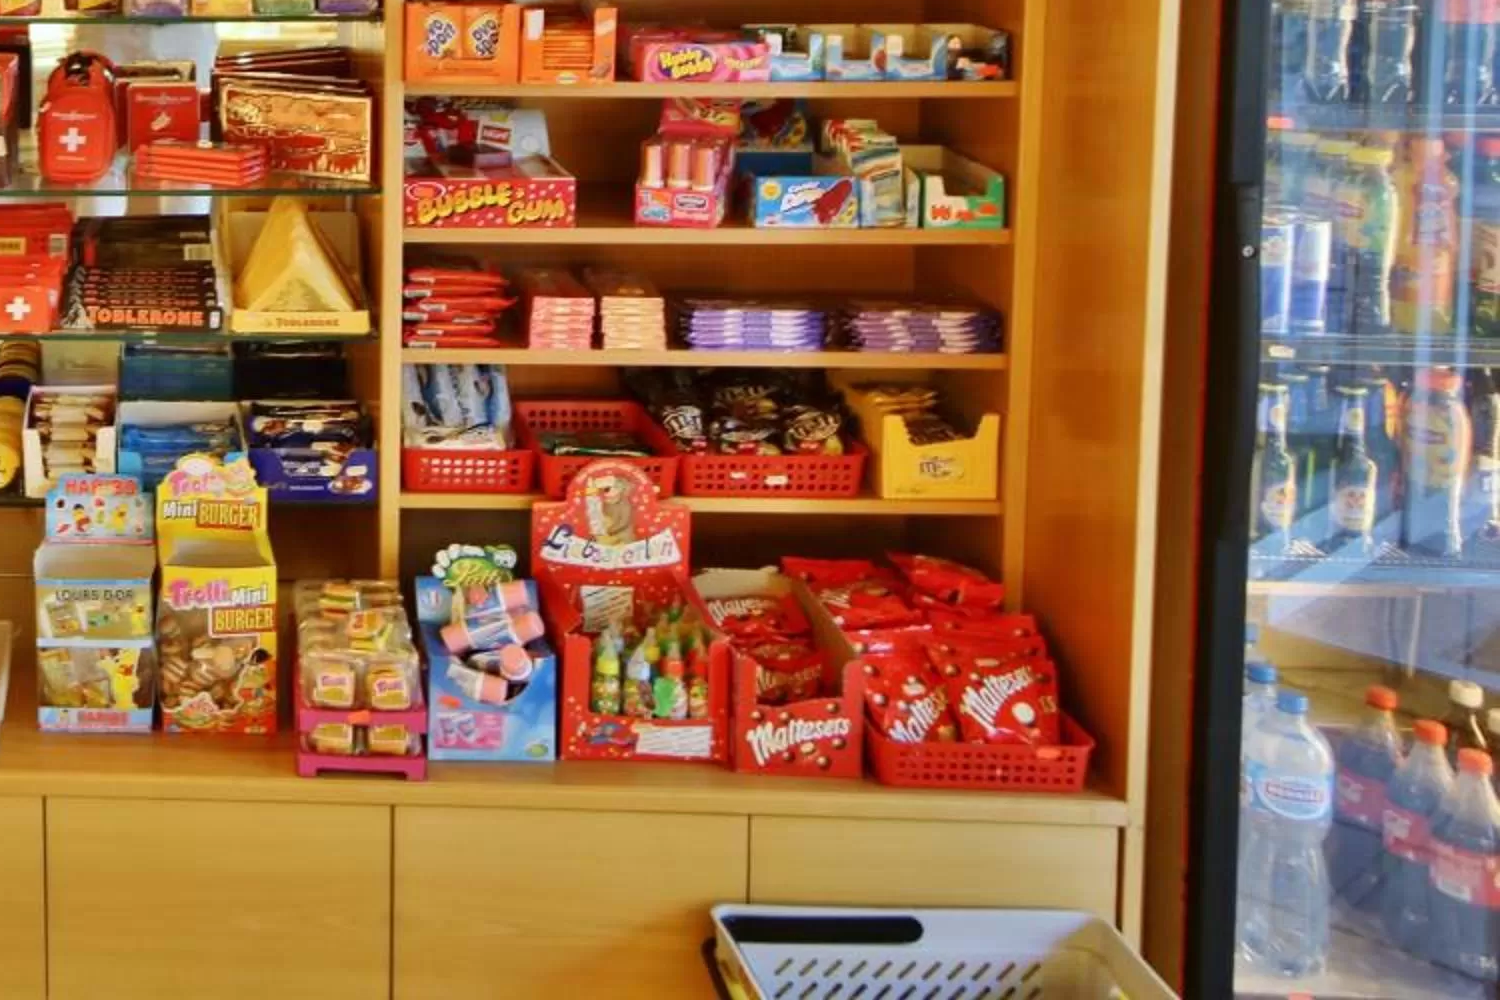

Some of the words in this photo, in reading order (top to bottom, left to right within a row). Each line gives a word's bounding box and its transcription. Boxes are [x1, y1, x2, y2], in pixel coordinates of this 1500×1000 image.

[416, 181, 512, 225] BUBBLE
[507, 198, 566, 225] GUM
[163, 501, 197, 519] Mini
[199, 503, 258, 527] BURGER
[230, 585, 268, 604] Mini
[214, 608, 274, 632] BURGER
[747, 716, 852, 768] Maltesers
